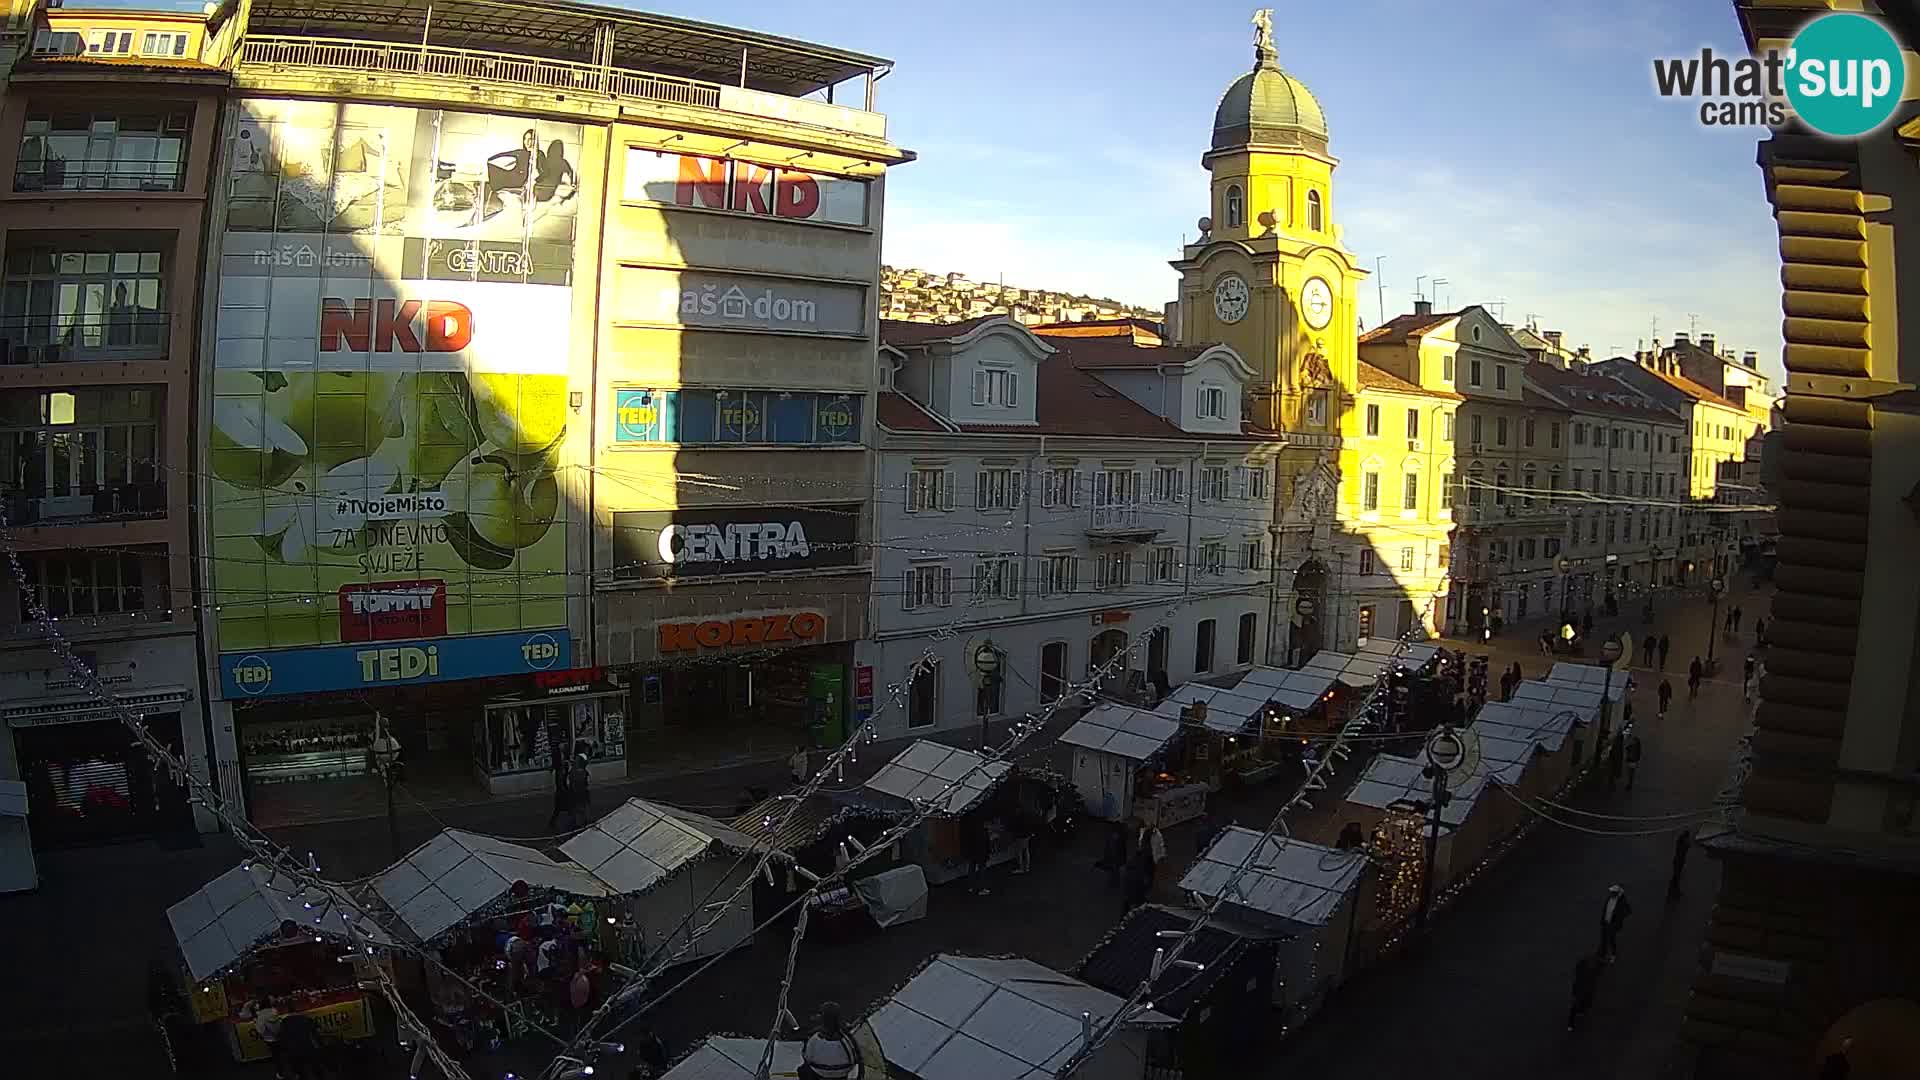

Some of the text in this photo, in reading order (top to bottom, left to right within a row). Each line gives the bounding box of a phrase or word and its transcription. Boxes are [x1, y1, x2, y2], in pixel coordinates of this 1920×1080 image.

[676, 155, 820, 219] NKD
[447, 249, 534, 275] CENTRA
[754, 288, 816, 322] dom
[319, 297, 474, 354] NKD
[617, 406, 657, 425] TEDi
[722, 409, 760, 426] TEDi
[820, 410, 853, 426] TEDi
[336, 494, 445, 517] #TvojeMisto
[332, 523, 450, 549] ZA DNEVNO
[658, 520, 811, 564] CENTRA
[358, 547, 426, 575] SVJEŽE
[346, 585, 438, 614] TOMMY
[658, 612, 826, 652] KORZO
[357, 646, 439, 683] TEDi
[521, 642, 560, 660] TEDi
[232, 664, 273, 684] TEDi
